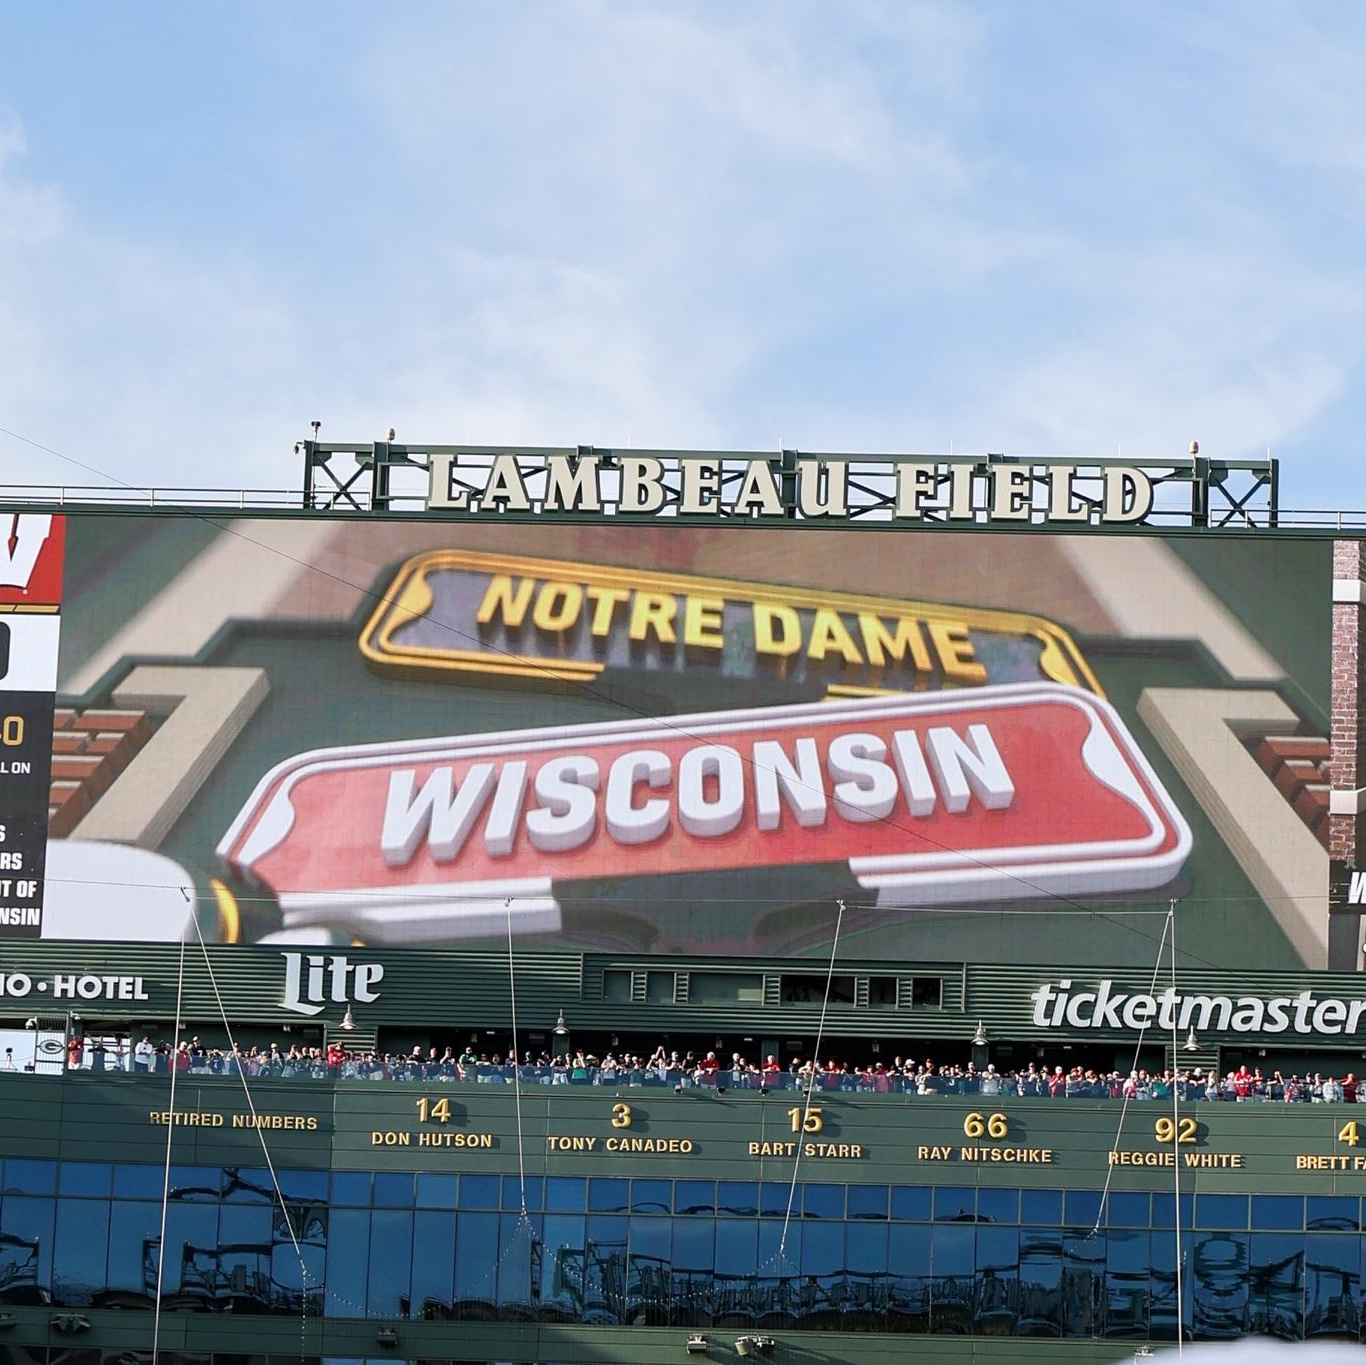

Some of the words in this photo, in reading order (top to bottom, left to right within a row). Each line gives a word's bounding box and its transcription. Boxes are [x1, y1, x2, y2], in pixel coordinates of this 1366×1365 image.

[428, 453, 848, 518] LAMBEAU
[897, 462, 1155, 523] FIELD
[476, 575, 724, 650] NOTRE
[752, 602, 987, 684] DAME
[11, 762, 31, 775] ON
[380, 724, 1016, 867] WISCONSIN
[16, 881, 38, 898] OF
[53, 975, 149, 1001] HOTEL
[277, 952, 385, 1015] Lite
[149, 1111, 224, 1128] RETIRED
[232, 1113, 318, 1131] NUMBERS
[415, 1097, 452, 1123] 14
[611, 1102, 632, 1129] 3
[787, 1106, 824, 1133] 15
[963, 1113, 1009, 1139] 66
[1155, 1117, 1198, 1144] 92
[1338, 1121, 1360, 1147] 4
[371, 1131, 410, 1146] DON
[419, 1132, 493, 1148] HUTSON
[547, 1136, 596, 1151] TONY
[606, 1138, 693, 1153] CANADEO
[748, 1141, 795, 1157] BART
[804, 1142, 862, 1158] STARR
[917, 1146, 951, 1161] RAY
[961, 1147, 1052, 1164] NITSCHKE
[1108, 1151, 1176, 1167] REGGIE
[1184, 1153, 1243, 1169] WHITE
[1296, 1155, 1351, 1171] BRETT
